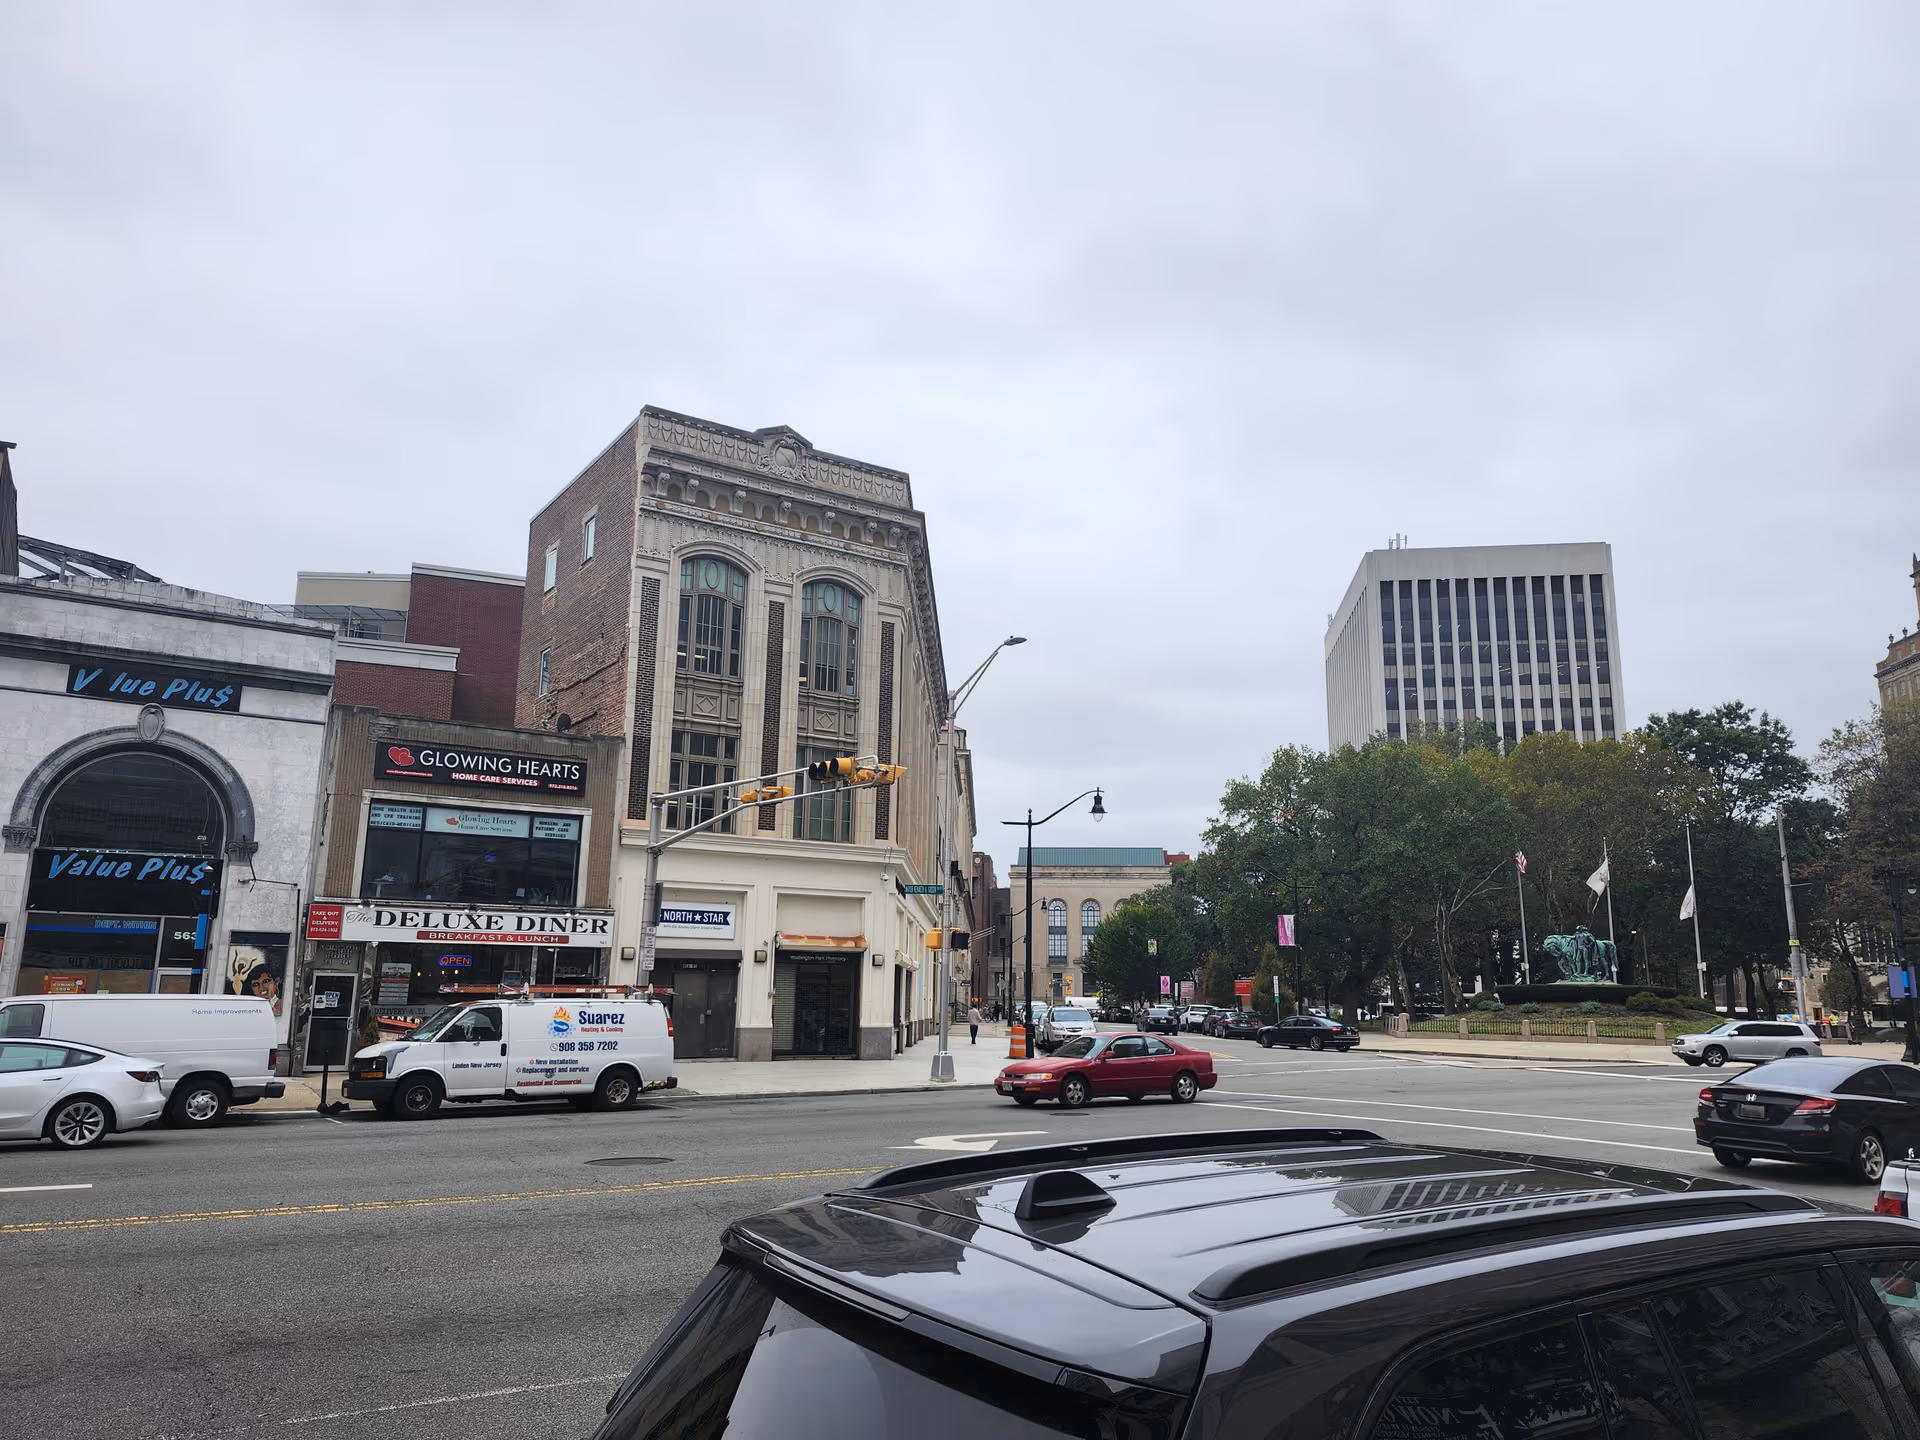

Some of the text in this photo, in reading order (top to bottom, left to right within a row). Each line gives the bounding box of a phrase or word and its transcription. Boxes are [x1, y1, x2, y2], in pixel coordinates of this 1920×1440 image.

[161, 678, 233, 707] Plu$
[420, 750, 580, 780] GLOWING HEARTS
[452, 772, 538, 787] HOME CARE SERVICES
[458, 813, 517, 826] Glowing Hearts
[48, 852, 209, 885] Value Plu$
[345, 910, 608, 934] The DELUXE DINER
[663, 910, 724, 923] NORTH STAR
[429, 931, 559, 943] BREAKFAST & LUNCH
[440, 955, 470, 965] OPEN
[214, 1008, 262, 1016] Improvements
[578, 1010, 625, 1025] Suarez
[580, 1026, 600, 1034] Heating
[558, 1040, 618, 1052] 908 358 7202
[521, 1066, 557, 1074] Replacement
[569, 1065, 590, 1073] service
[516, 1079, 544, 1087] Residential
[553, 1078, 582, 1086] Commercial
